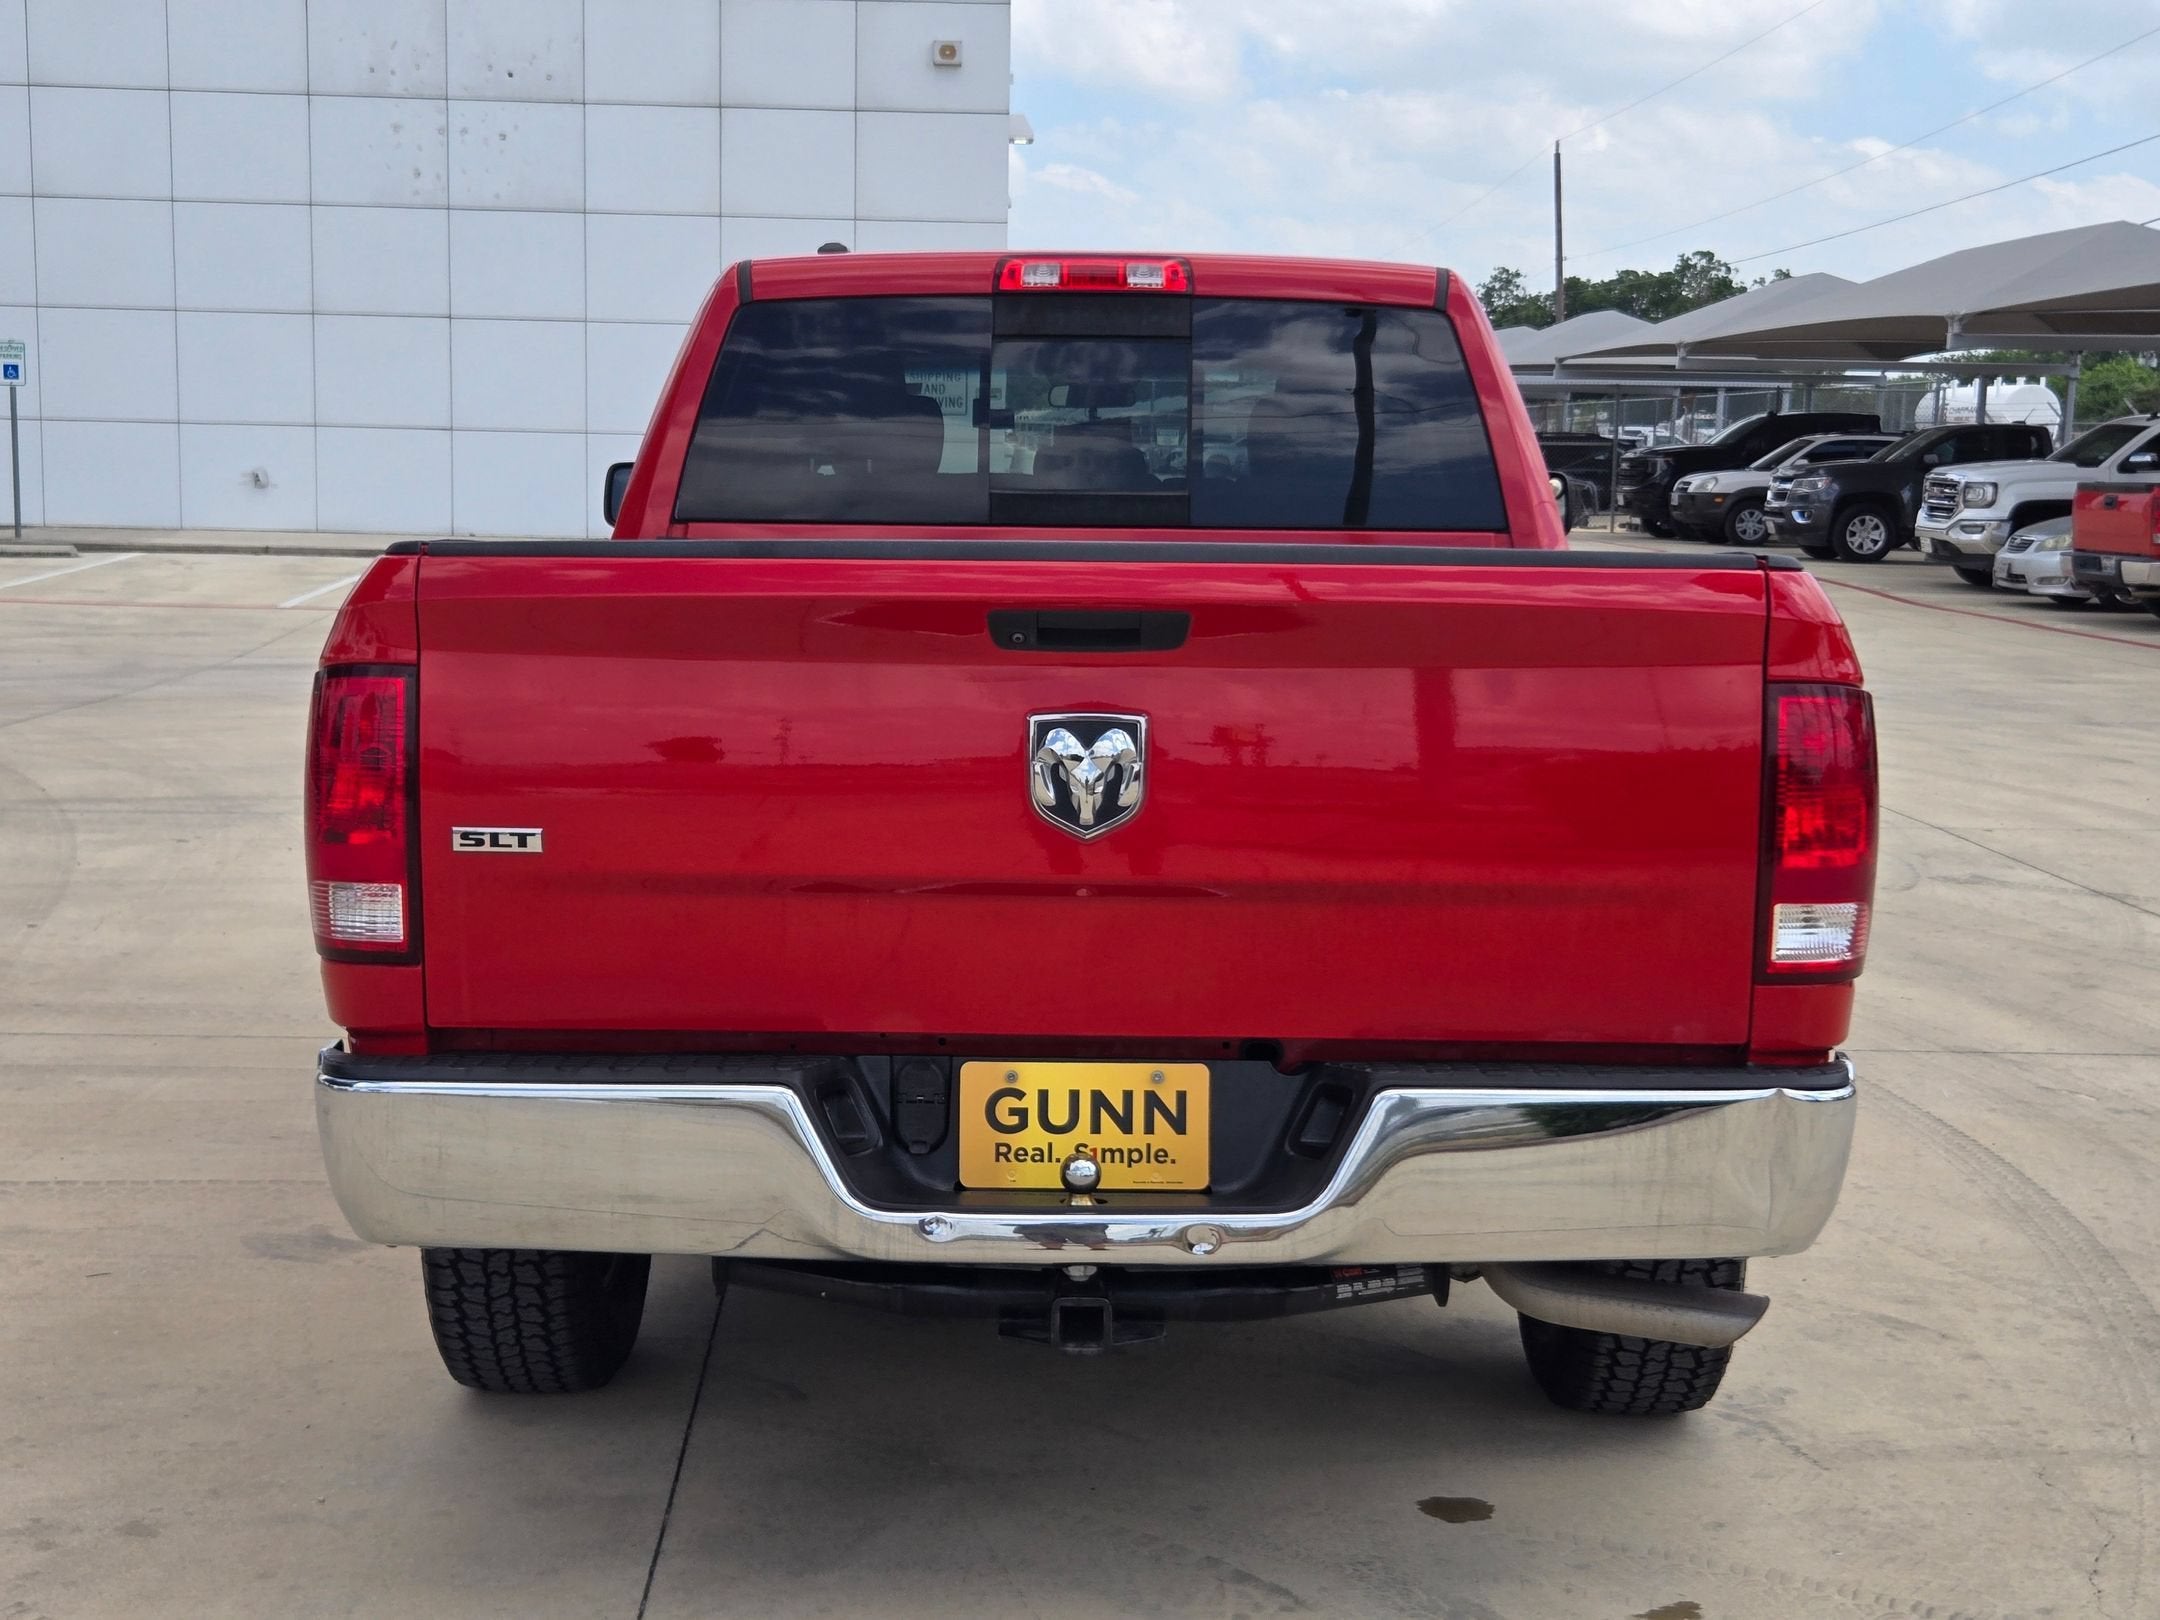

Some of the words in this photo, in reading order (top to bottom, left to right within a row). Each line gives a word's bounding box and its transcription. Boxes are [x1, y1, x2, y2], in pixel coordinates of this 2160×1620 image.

[924, 383, 946, 395] AND
[459, 832, 536, 848] SLT
[984, 1086, 1188, 1136] GUNN
[994, 1142, 1061, 1163] Real.
